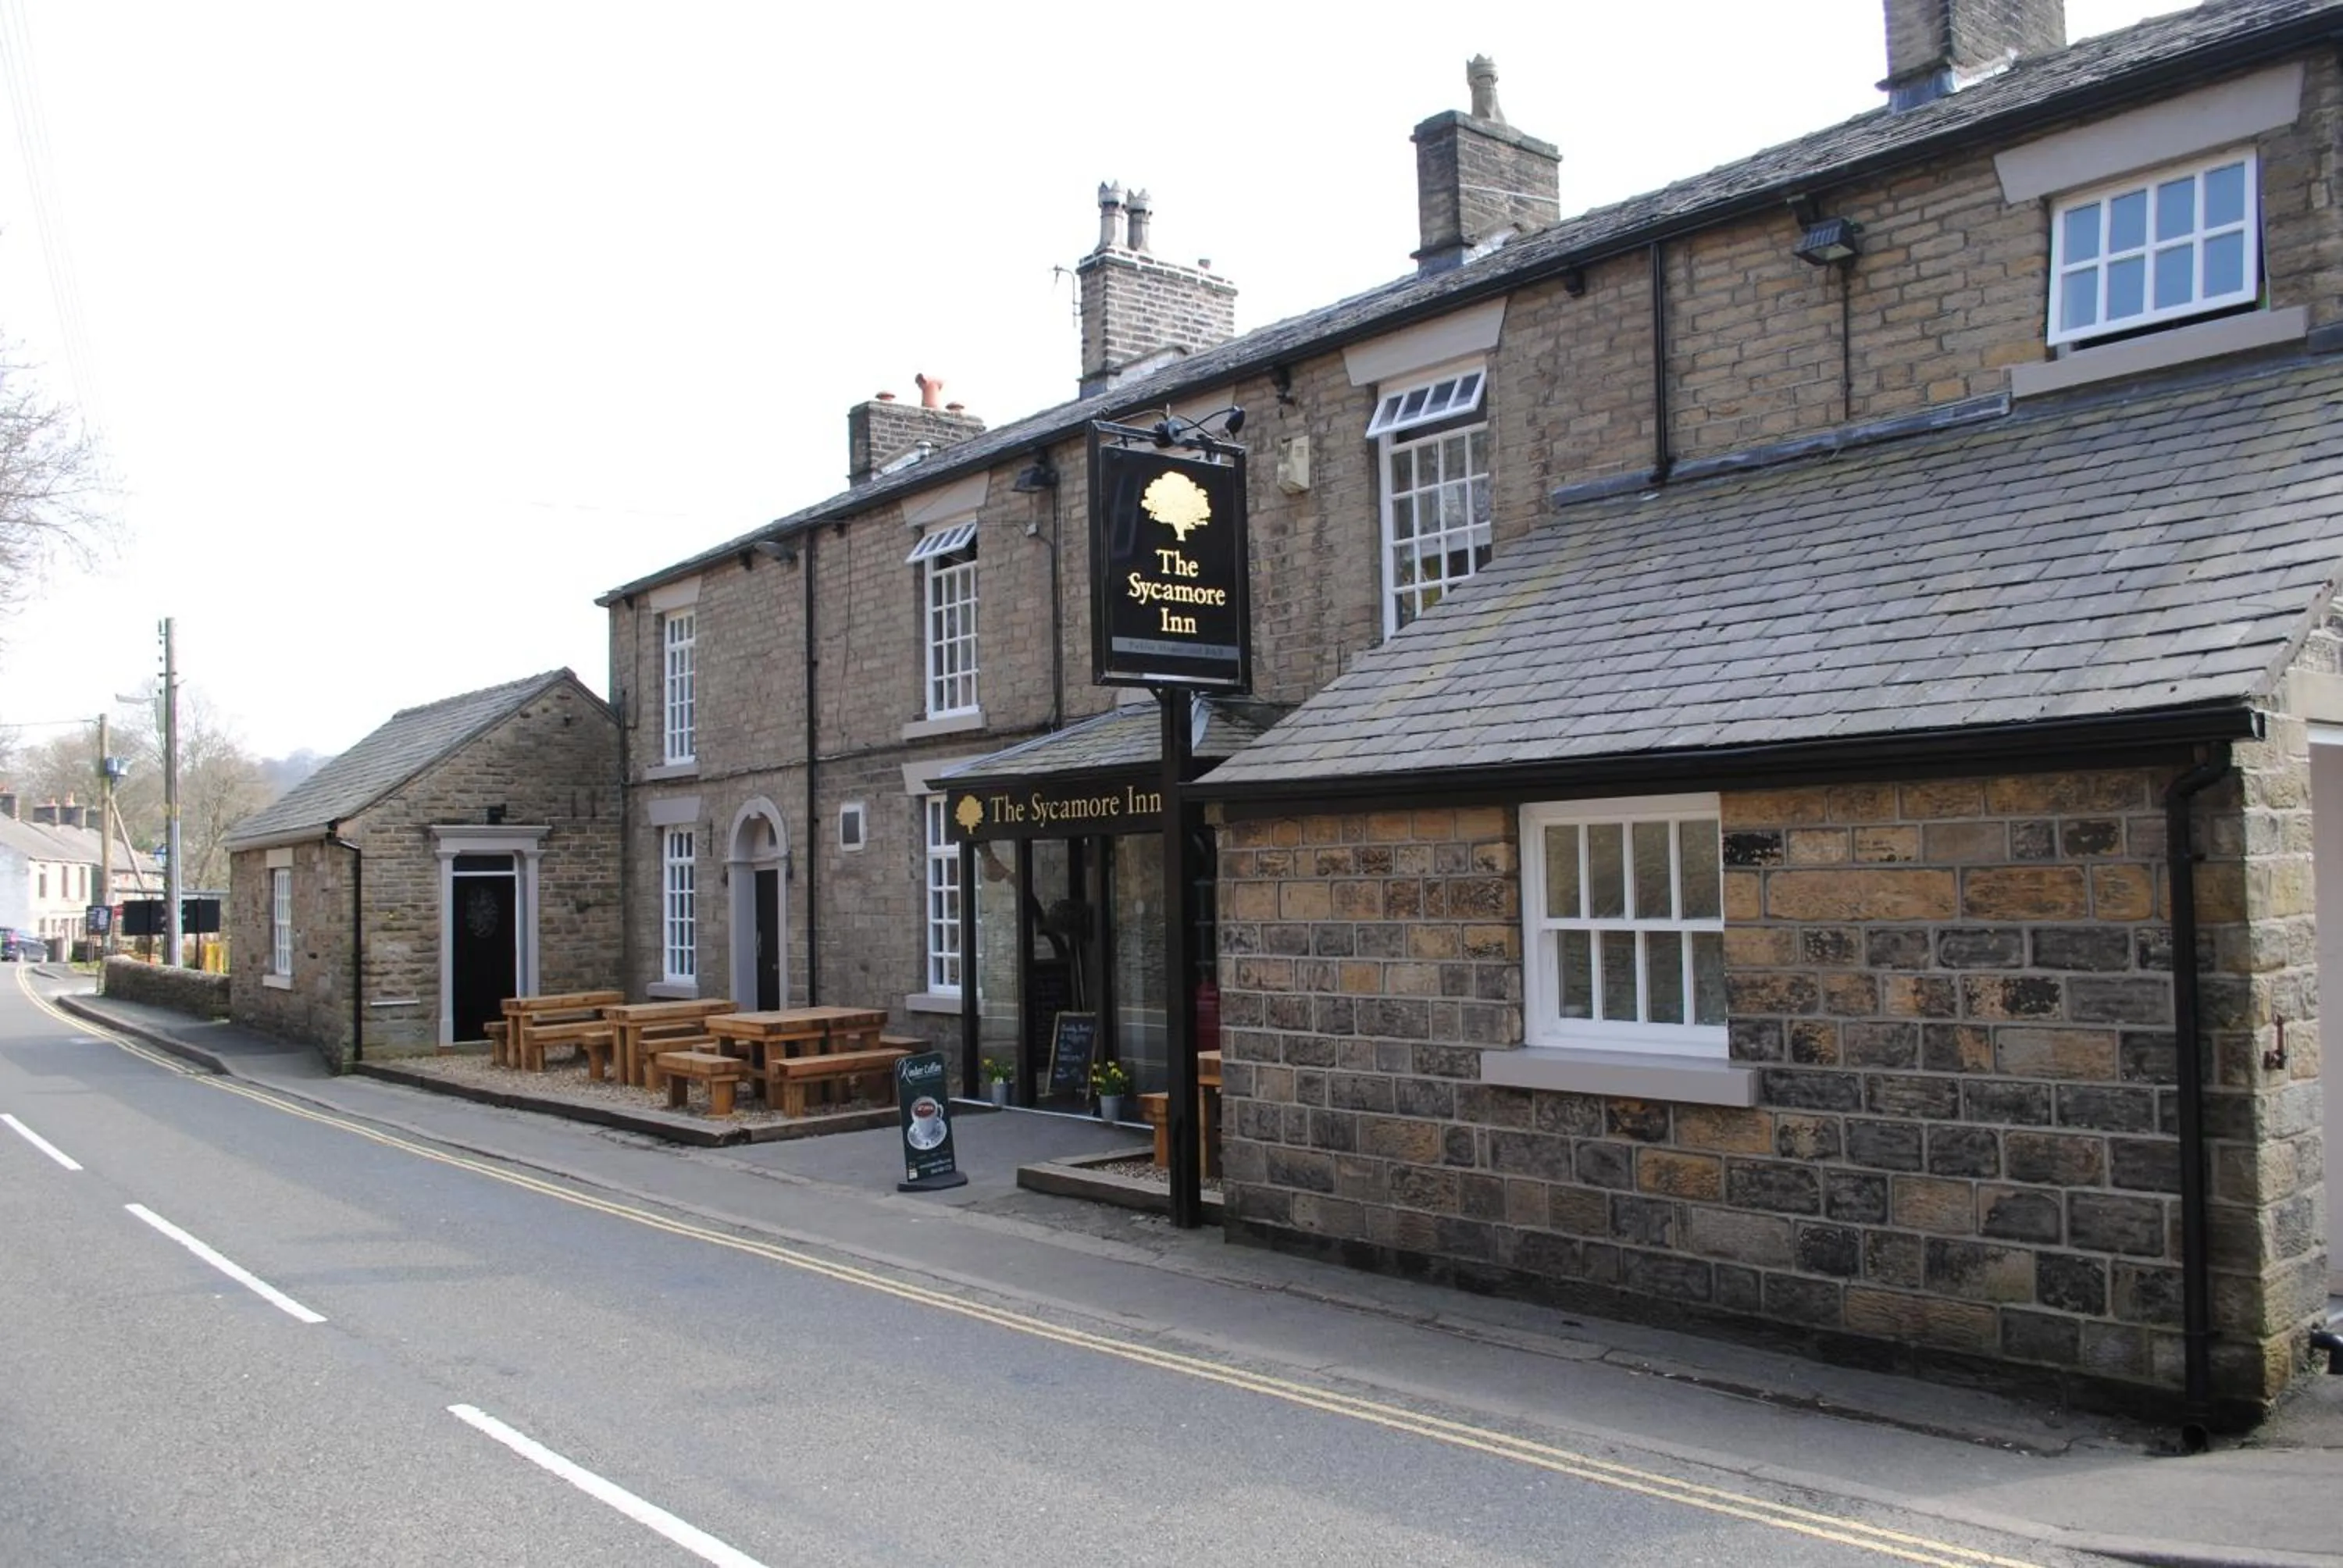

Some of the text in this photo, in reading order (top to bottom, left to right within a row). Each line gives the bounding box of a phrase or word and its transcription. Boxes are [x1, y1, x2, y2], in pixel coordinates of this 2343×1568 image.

[1156, 550, 1199, 576] The
[1128, 572, 1225, 605] Sycamore
[1161, 608, 1197, 633] Inn
[990, 786, 1162, 827] The Sycamore Inn
